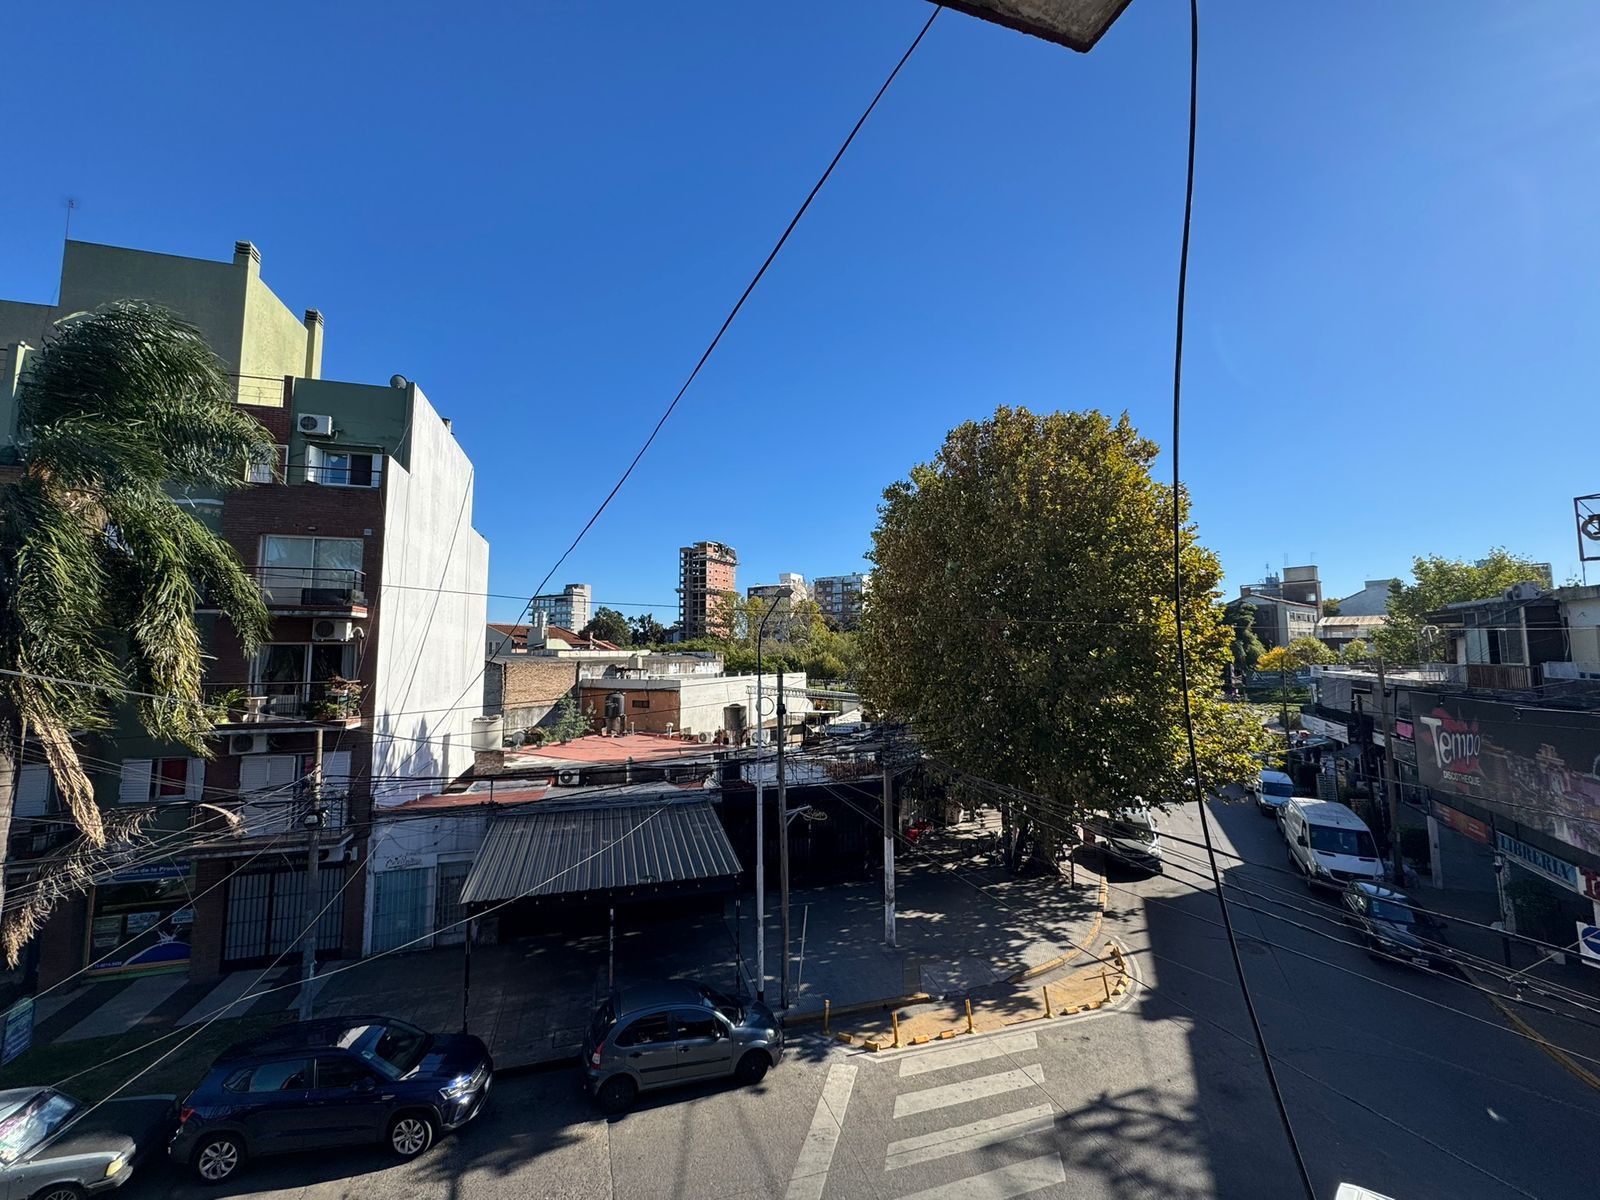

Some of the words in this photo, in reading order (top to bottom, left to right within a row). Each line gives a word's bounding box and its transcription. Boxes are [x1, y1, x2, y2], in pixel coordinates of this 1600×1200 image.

[1419, 716, 1481, 769] Tempo
[1442, 770, 1481, 786] DISCOTHEQUE
[1500, 834, 1569, 880] LIBRERIA
